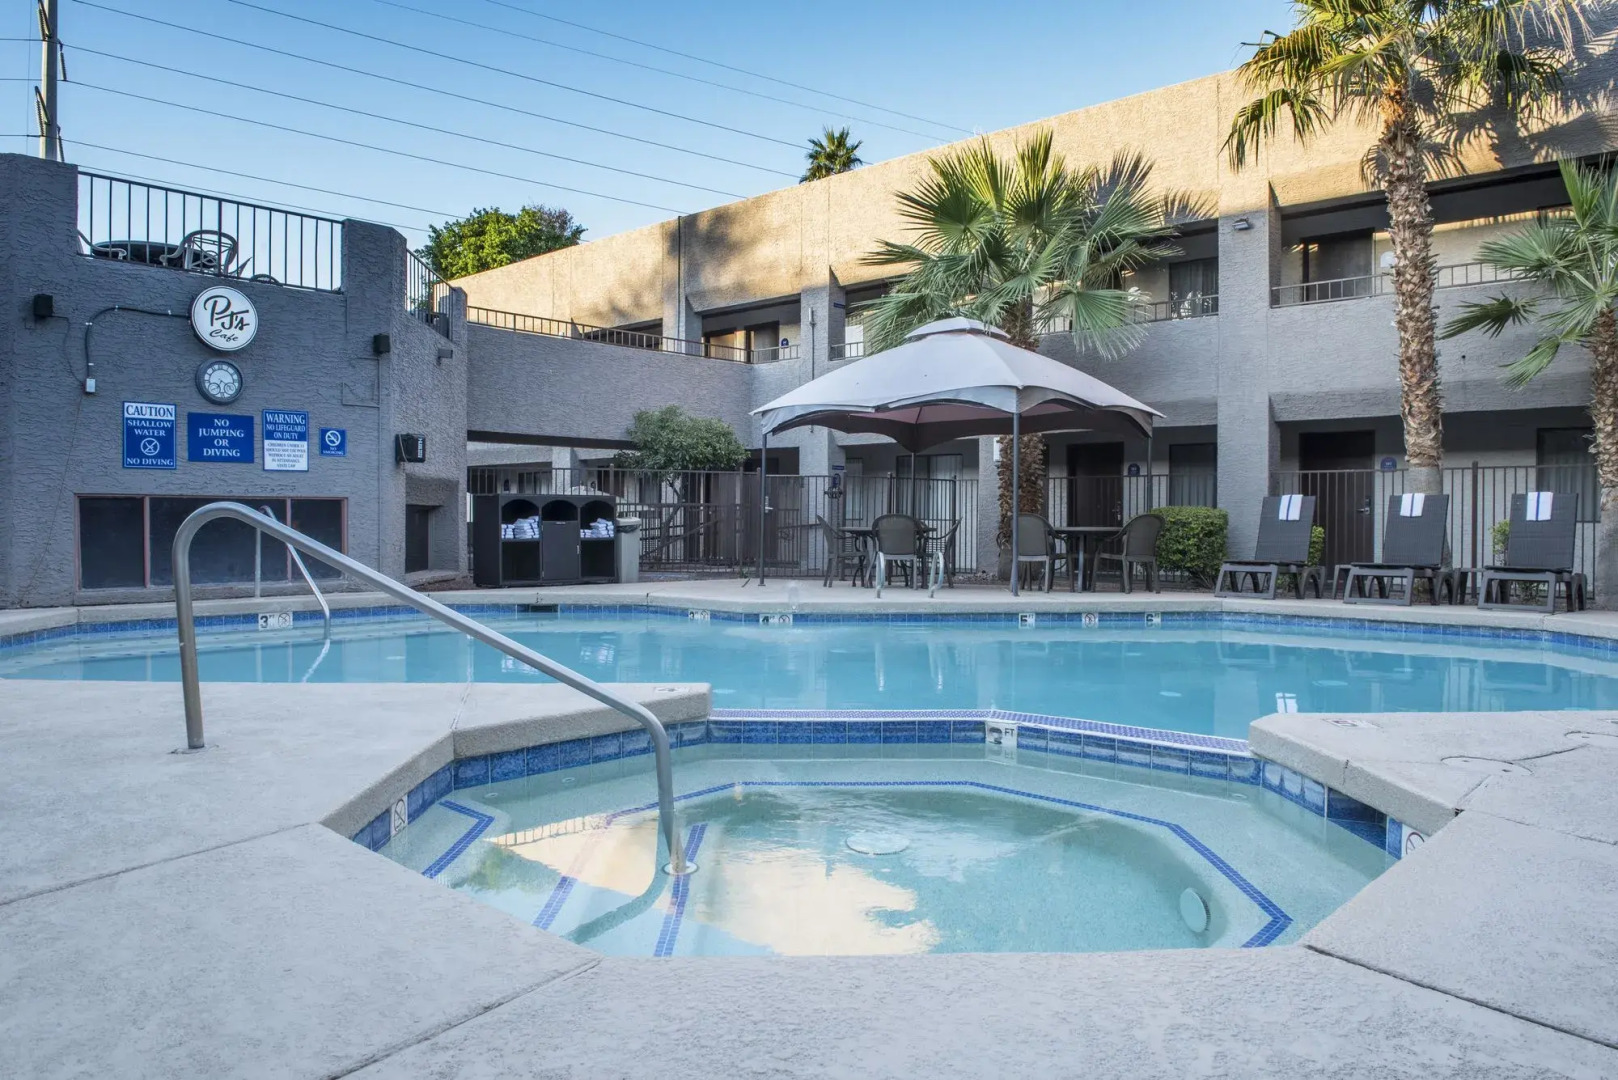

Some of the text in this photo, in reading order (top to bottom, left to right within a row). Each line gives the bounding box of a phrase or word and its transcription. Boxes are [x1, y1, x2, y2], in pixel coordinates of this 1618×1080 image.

[203, 294, 250, 331] PJ's
[209, 329, 239, 342] Cafe
[126, 404, 174, 418] CAUTION
[127, 419, 172, 428] SHALLOW
[213, 418, 230, 427] NO
[266, 413, 305, 425] WARNING
[134, 428, 166, 437] WATER
[198, 427, 245, 438] JUMPING
[276, 424, 305, 432] LIFEGUARD
[273, 431, 283, 439] ON
[213, 438, 230, 447] OR
[203, 447, 241, 458] DIVING
[126, 457, 174, 467] NO DIVING
[1004, 728, 1015, 737] FT
